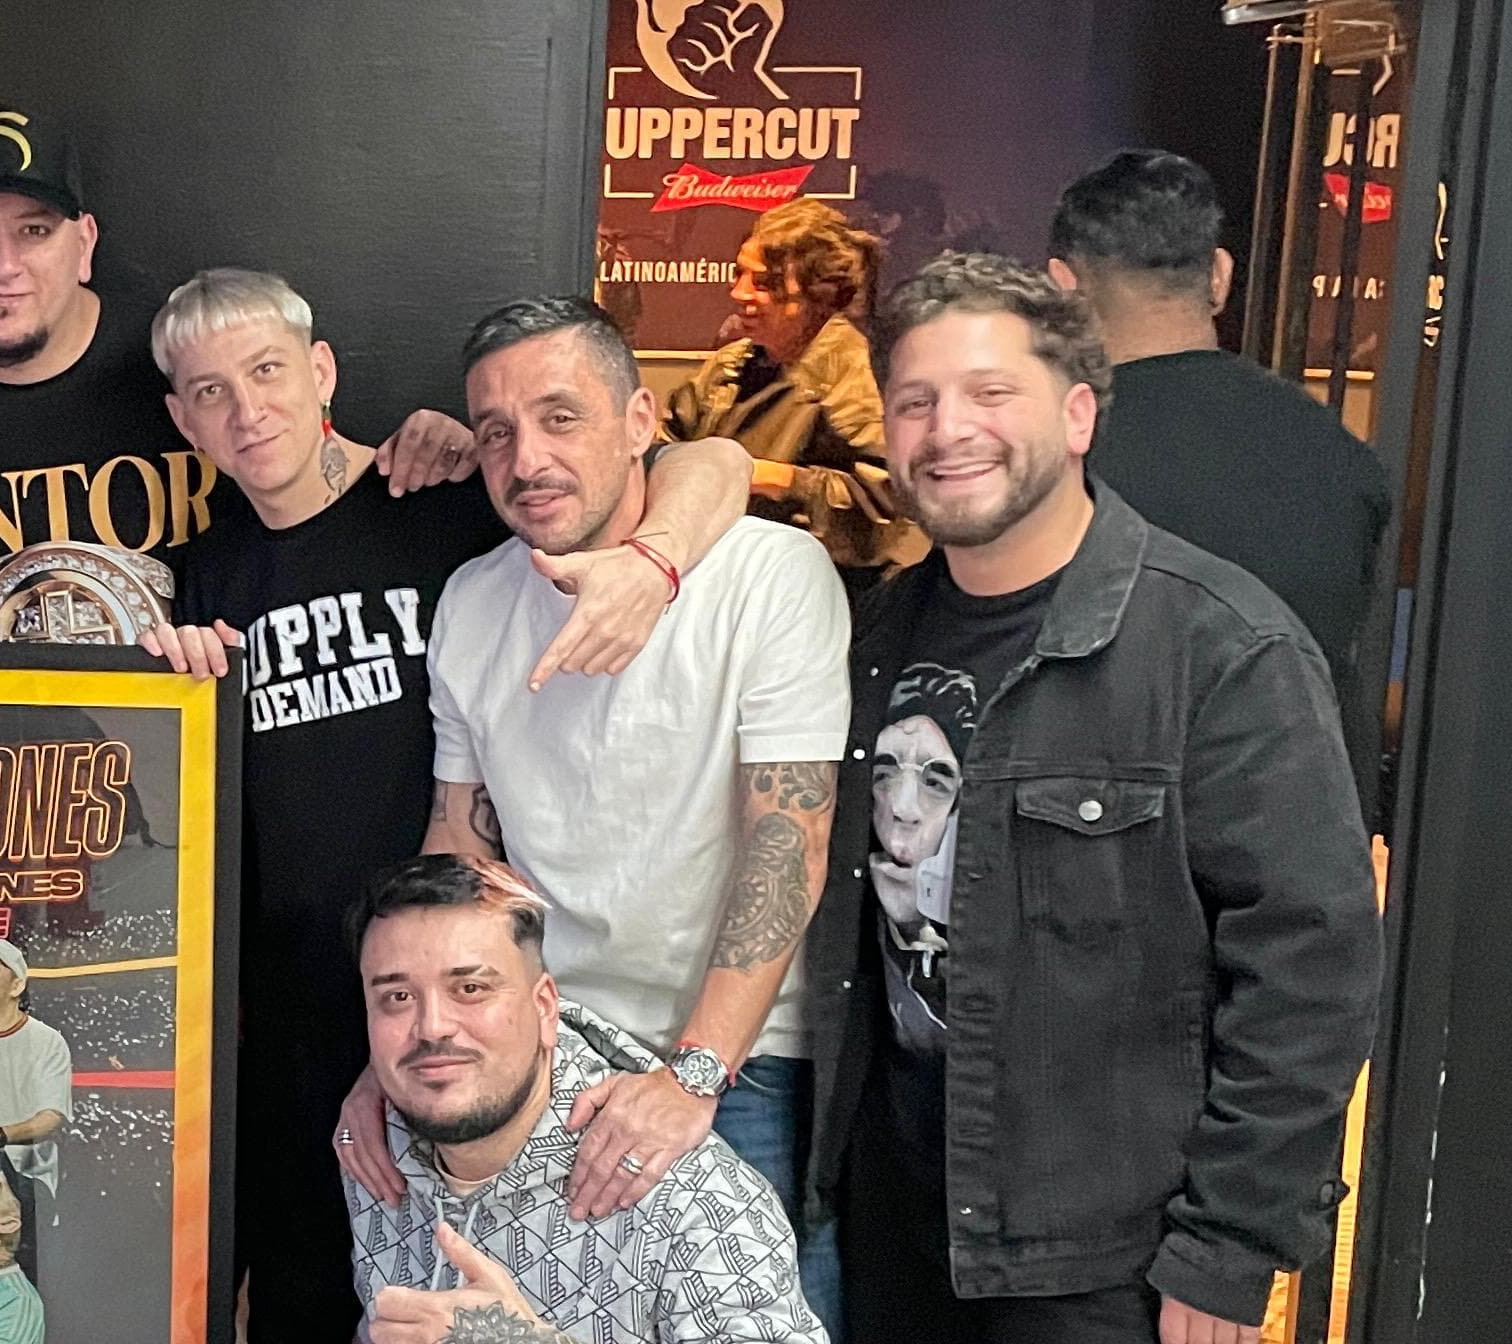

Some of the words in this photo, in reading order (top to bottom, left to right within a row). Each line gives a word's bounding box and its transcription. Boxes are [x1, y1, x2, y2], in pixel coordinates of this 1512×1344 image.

[605, 107, 860, 160] UPPERCUT
[662, 174, 798, 200] Budweiser
[241, 587, 426, 697] UPPLY
[249, 657, 403, 733] DEMAND
